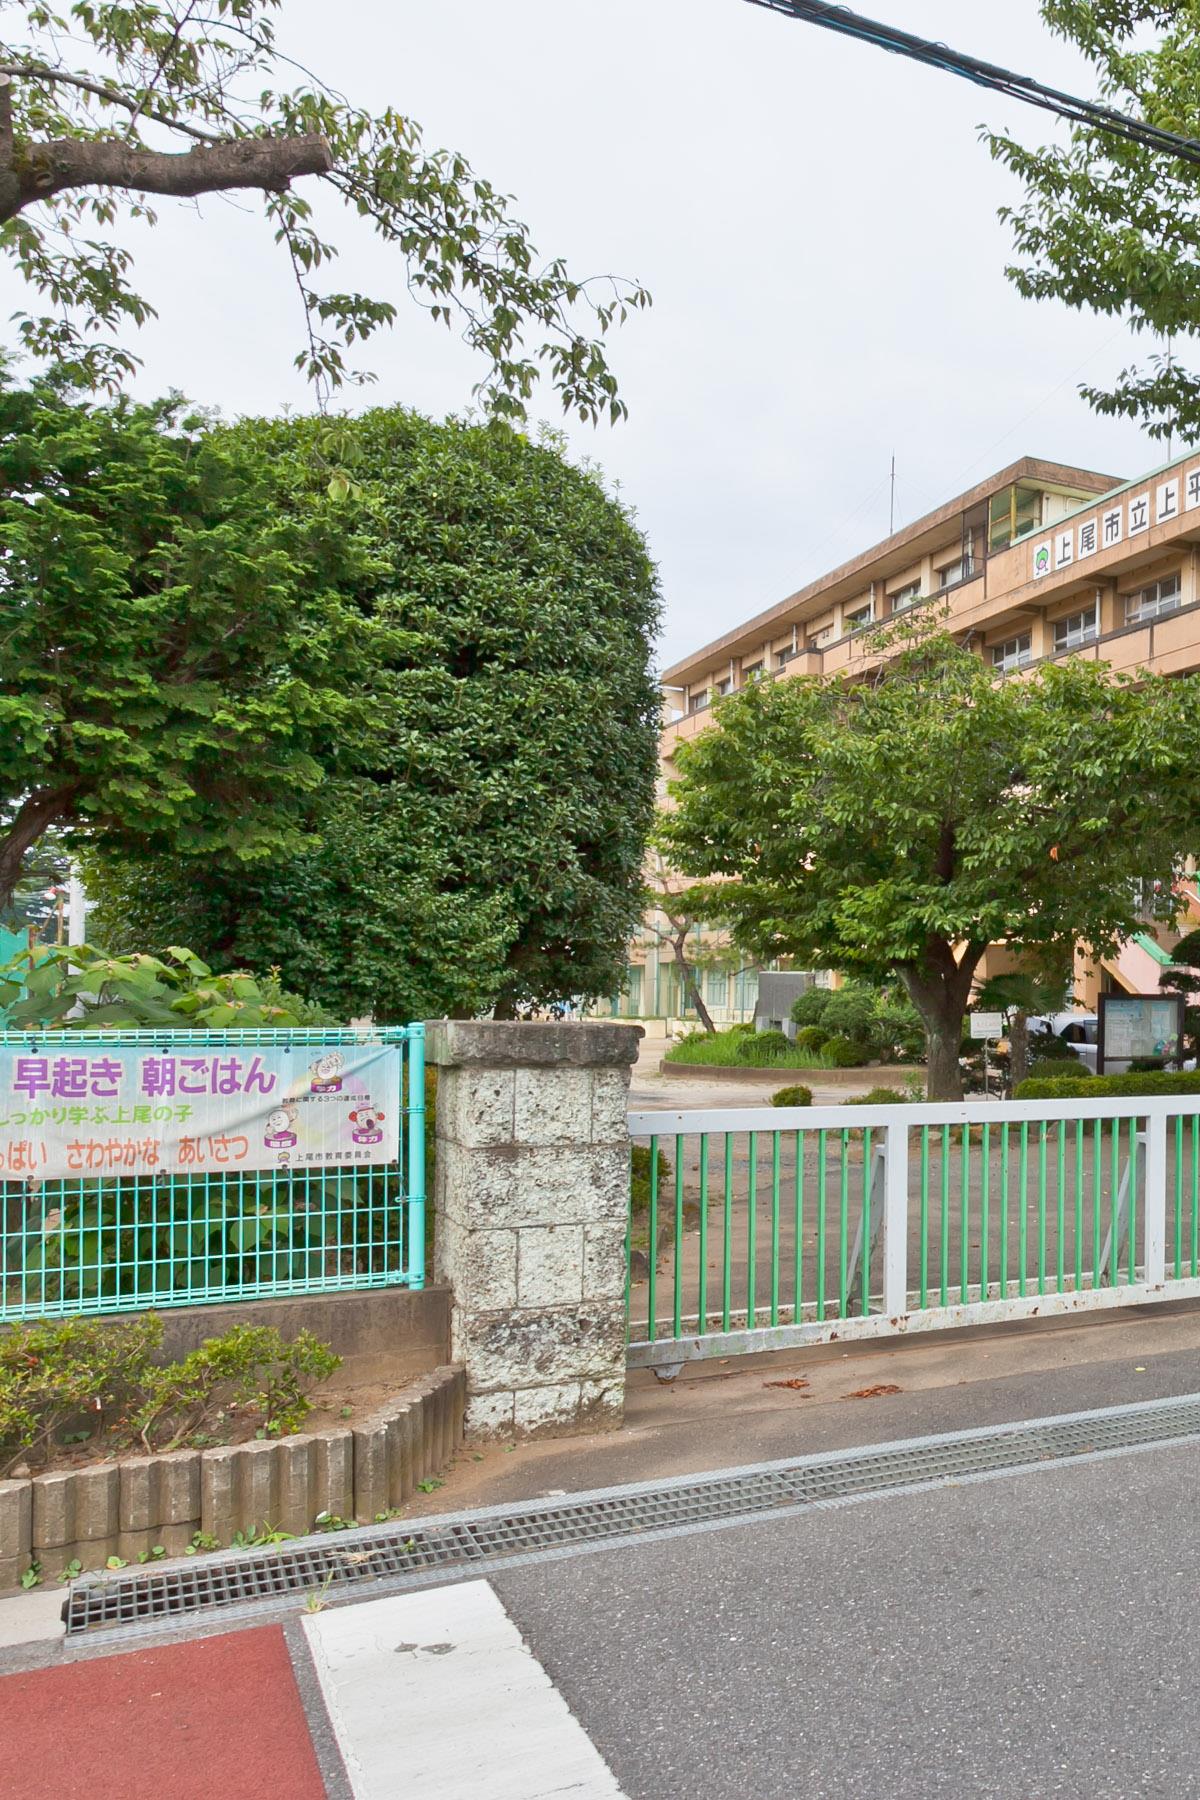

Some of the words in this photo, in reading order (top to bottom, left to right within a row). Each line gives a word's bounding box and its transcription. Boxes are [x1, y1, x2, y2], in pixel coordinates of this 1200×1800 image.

[13, 1057, 123, 1099] 早起き
[141, 1057, 276, 1097] 朝ごはん
[66, 1137, 161, 1169] さわやかな
[178, 1135, 249, 1163] あいさつ
